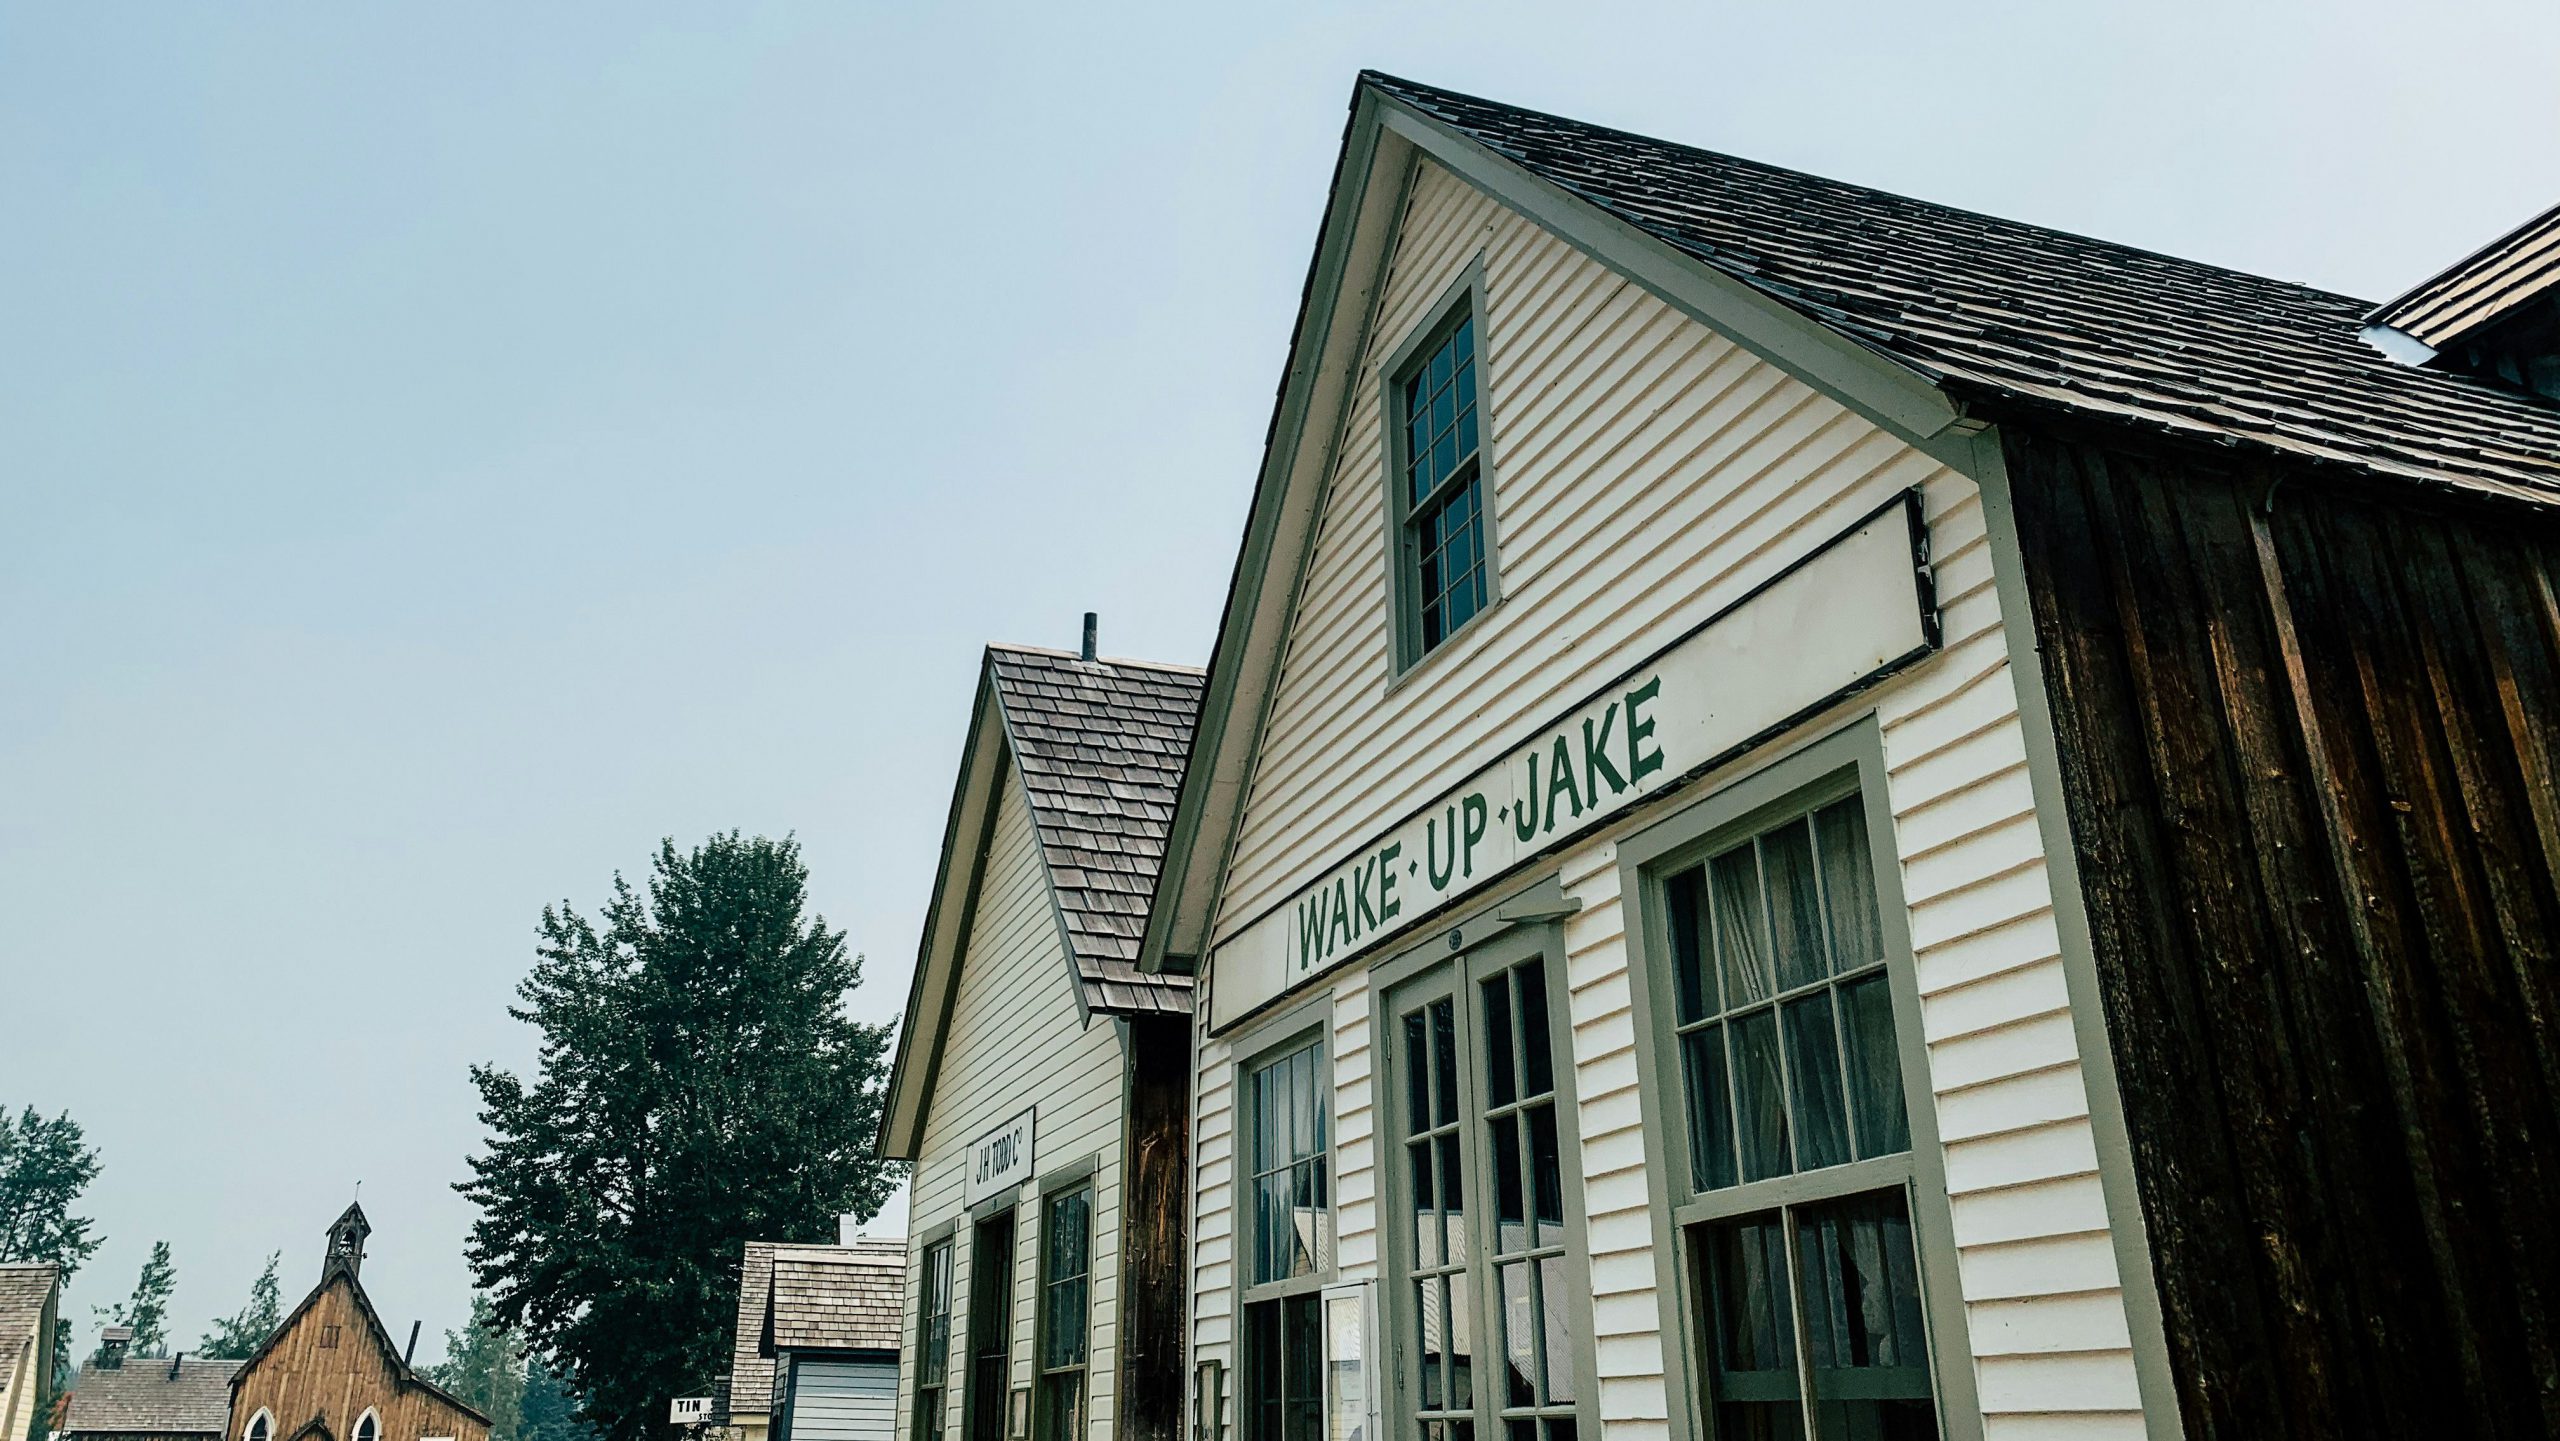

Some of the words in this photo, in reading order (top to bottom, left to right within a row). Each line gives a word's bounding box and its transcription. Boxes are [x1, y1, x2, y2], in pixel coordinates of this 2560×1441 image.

[1299, 840, 1401, 971] WAKE
[1427, 792, 1487, 891] UP
[1513, 674, 1665, 843] JAKE
[992, 1134, 1011, 1178] TODD
[677, 1400, 700, 1412] TIN
